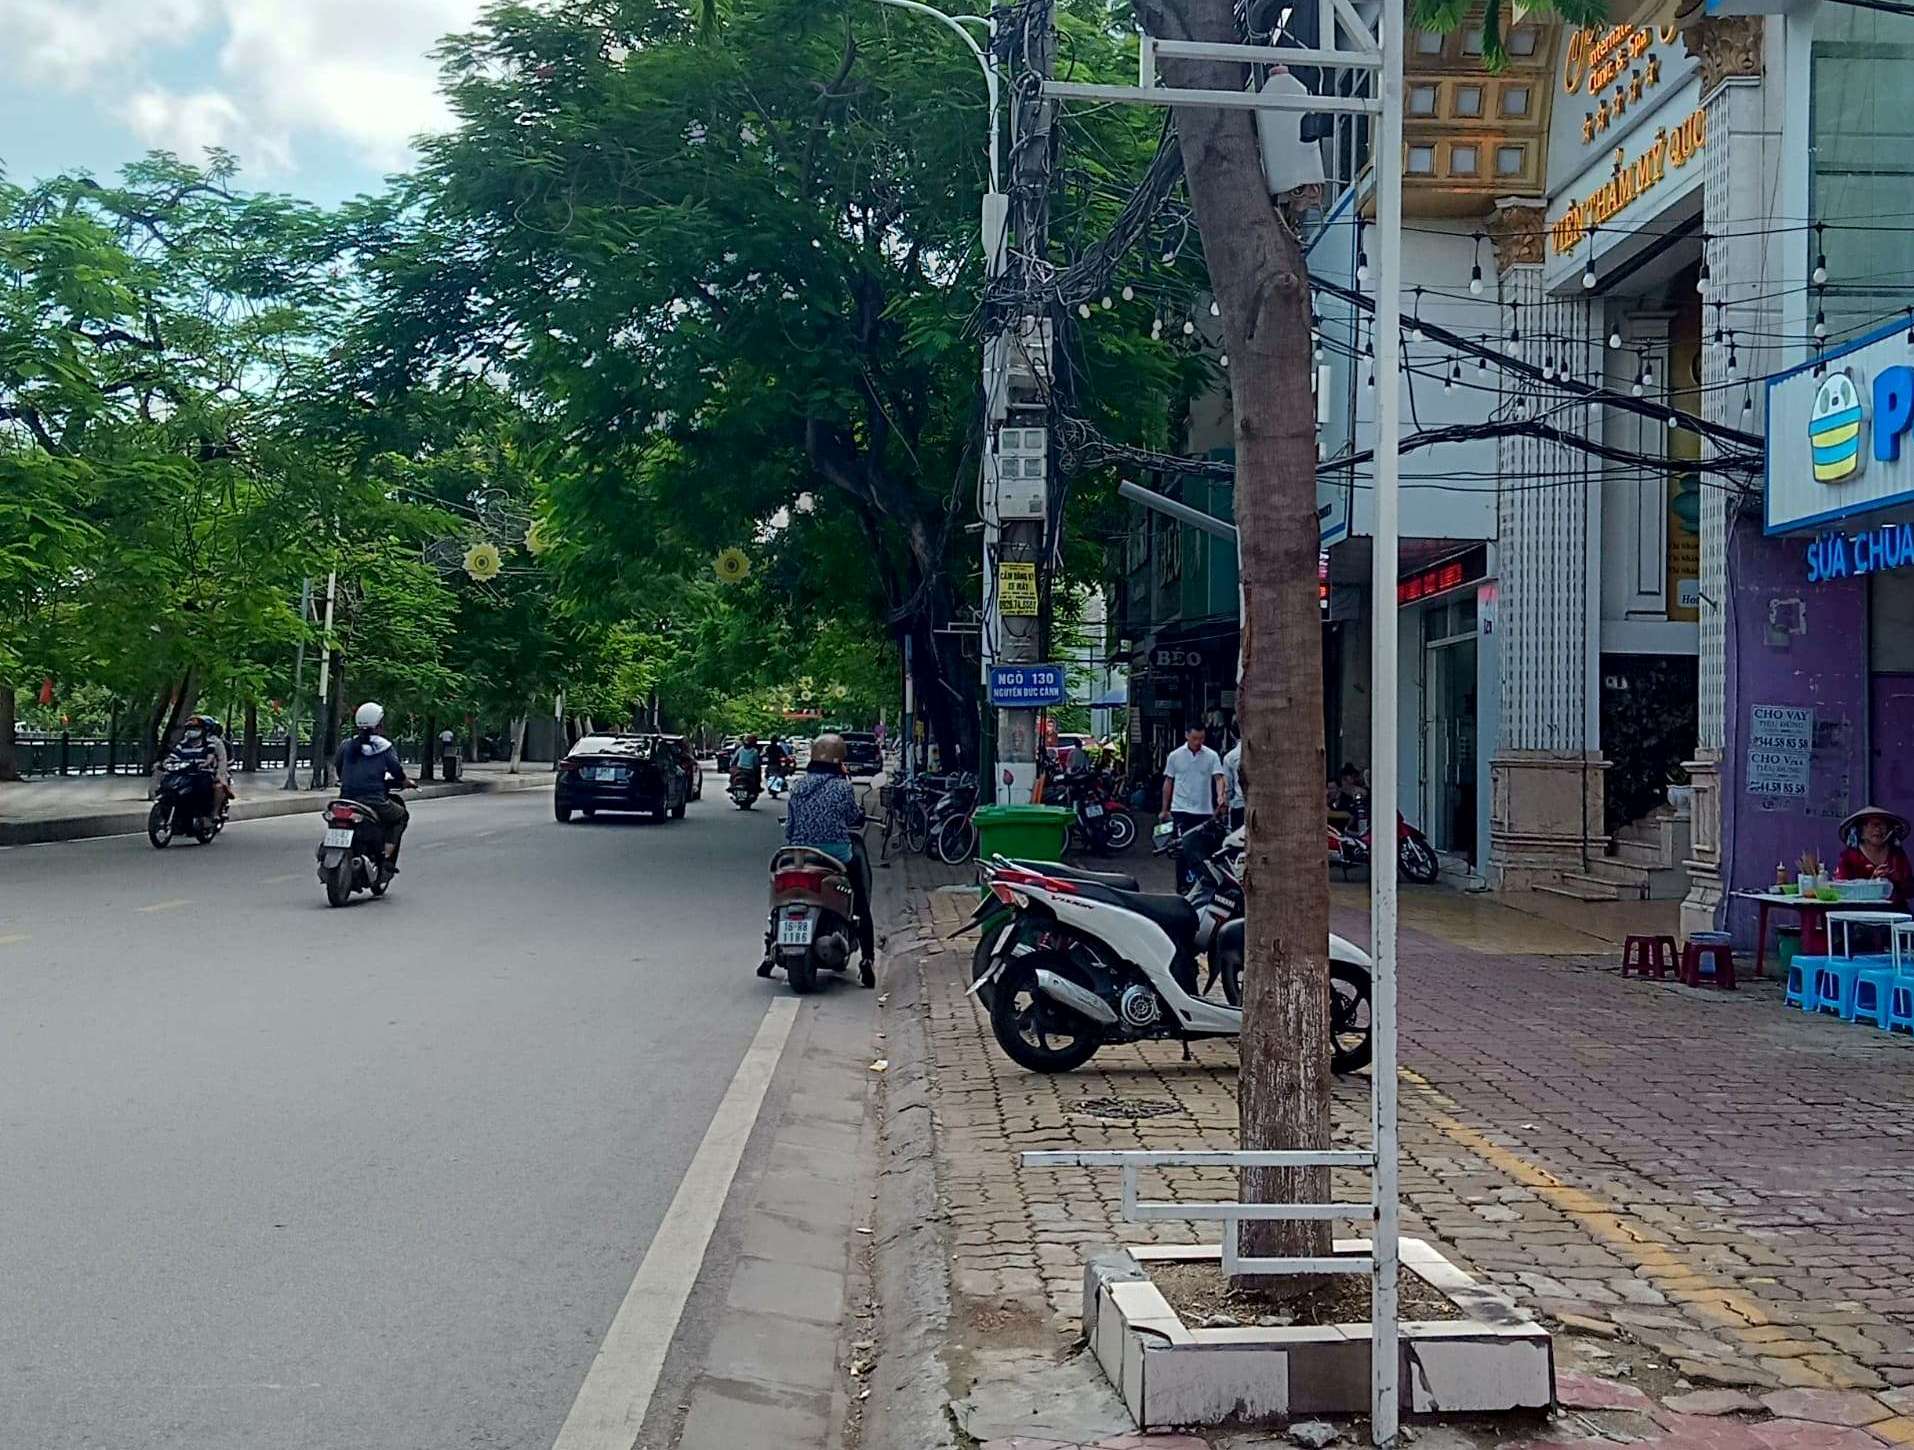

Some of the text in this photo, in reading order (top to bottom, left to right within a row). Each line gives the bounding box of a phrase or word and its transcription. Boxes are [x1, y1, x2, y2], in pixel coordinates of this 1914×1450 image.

[1628, 27, 1651, 58] Spa
[1669, 109, 1706, 168] QUO
[998, 670, 1054, 685] NGÕ 130
[1754, 708, 1809, 721] CHO VAY
[1751, 753, 1780, 765] CHO
